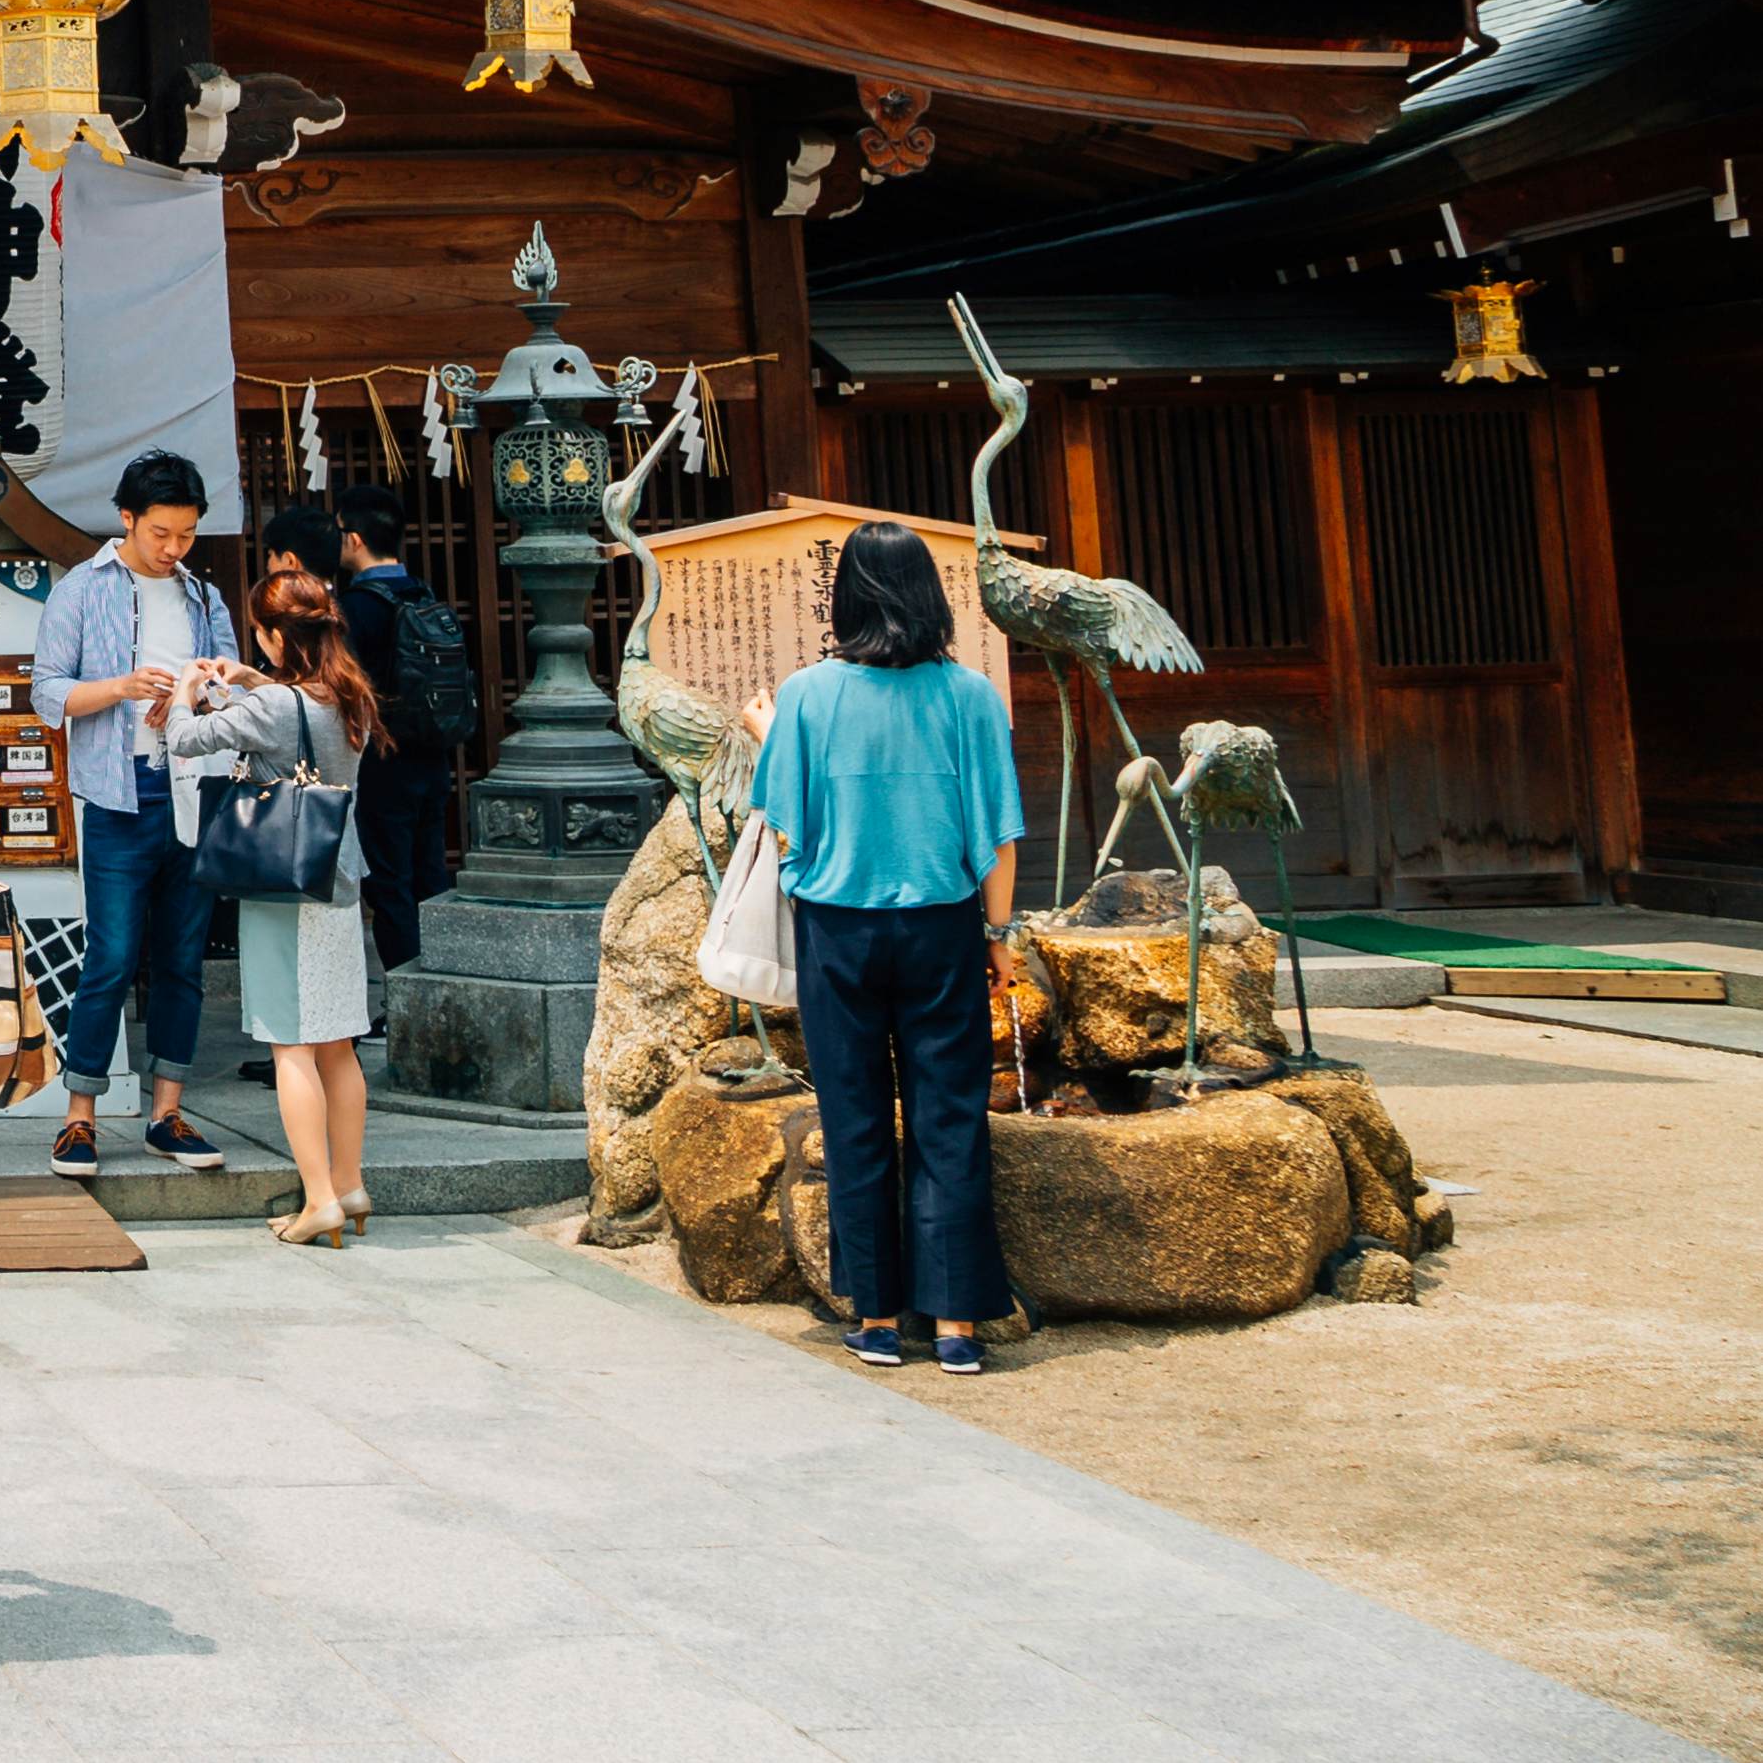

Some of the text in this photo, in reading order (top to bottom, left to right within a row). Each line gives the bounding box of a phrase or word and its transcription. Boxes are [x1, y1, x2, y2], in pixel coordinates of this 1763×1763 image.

[10, 750, 45, 761] 韓国語
[11, 811, 46, 823] 台湾語
